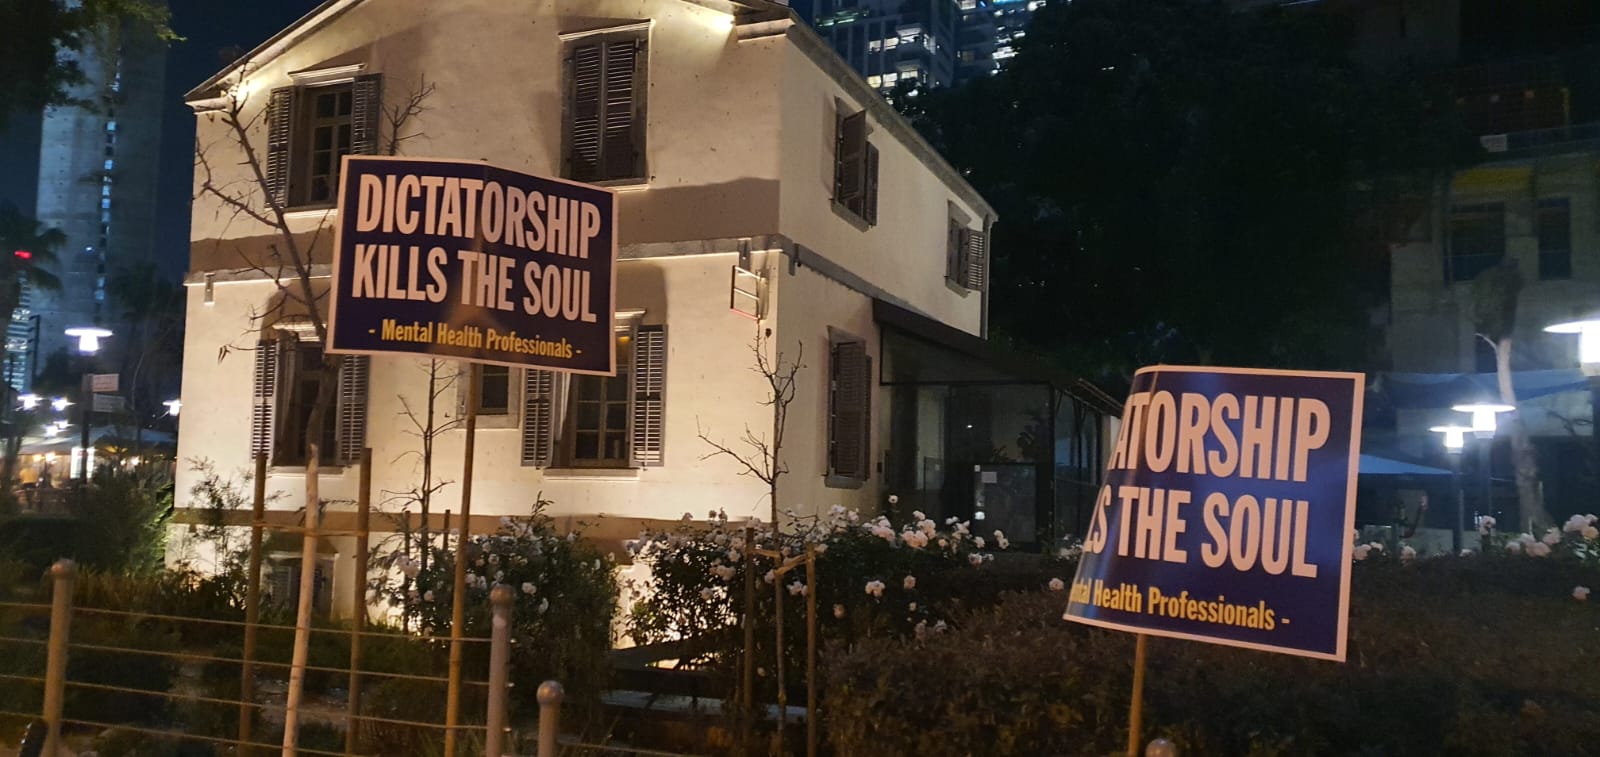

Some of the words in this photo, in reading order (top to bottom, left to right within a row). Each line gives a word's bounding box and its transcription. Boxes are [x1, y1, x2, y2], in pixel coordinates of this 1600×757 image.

[356, 173, 601, 259] DICTATORSHIP
[352, 243, 448, 304] KILLS
[457, 250, 516, 311] THE
[523, 261, 597, 323] SOUL
[381, 318, 433, 344] Mental
[437, 322, 482, 348] Health
[486, 328, 573, 360] Professionals
[1107, 389, 1331, 482] ATORSHIP
[1118, 485, 1192, 564] THE
[1200, 492, 1318, 579] SOUL
[1092, 578, 1143, 614] Health
[1148, 587, 1276, 631] Professionals
